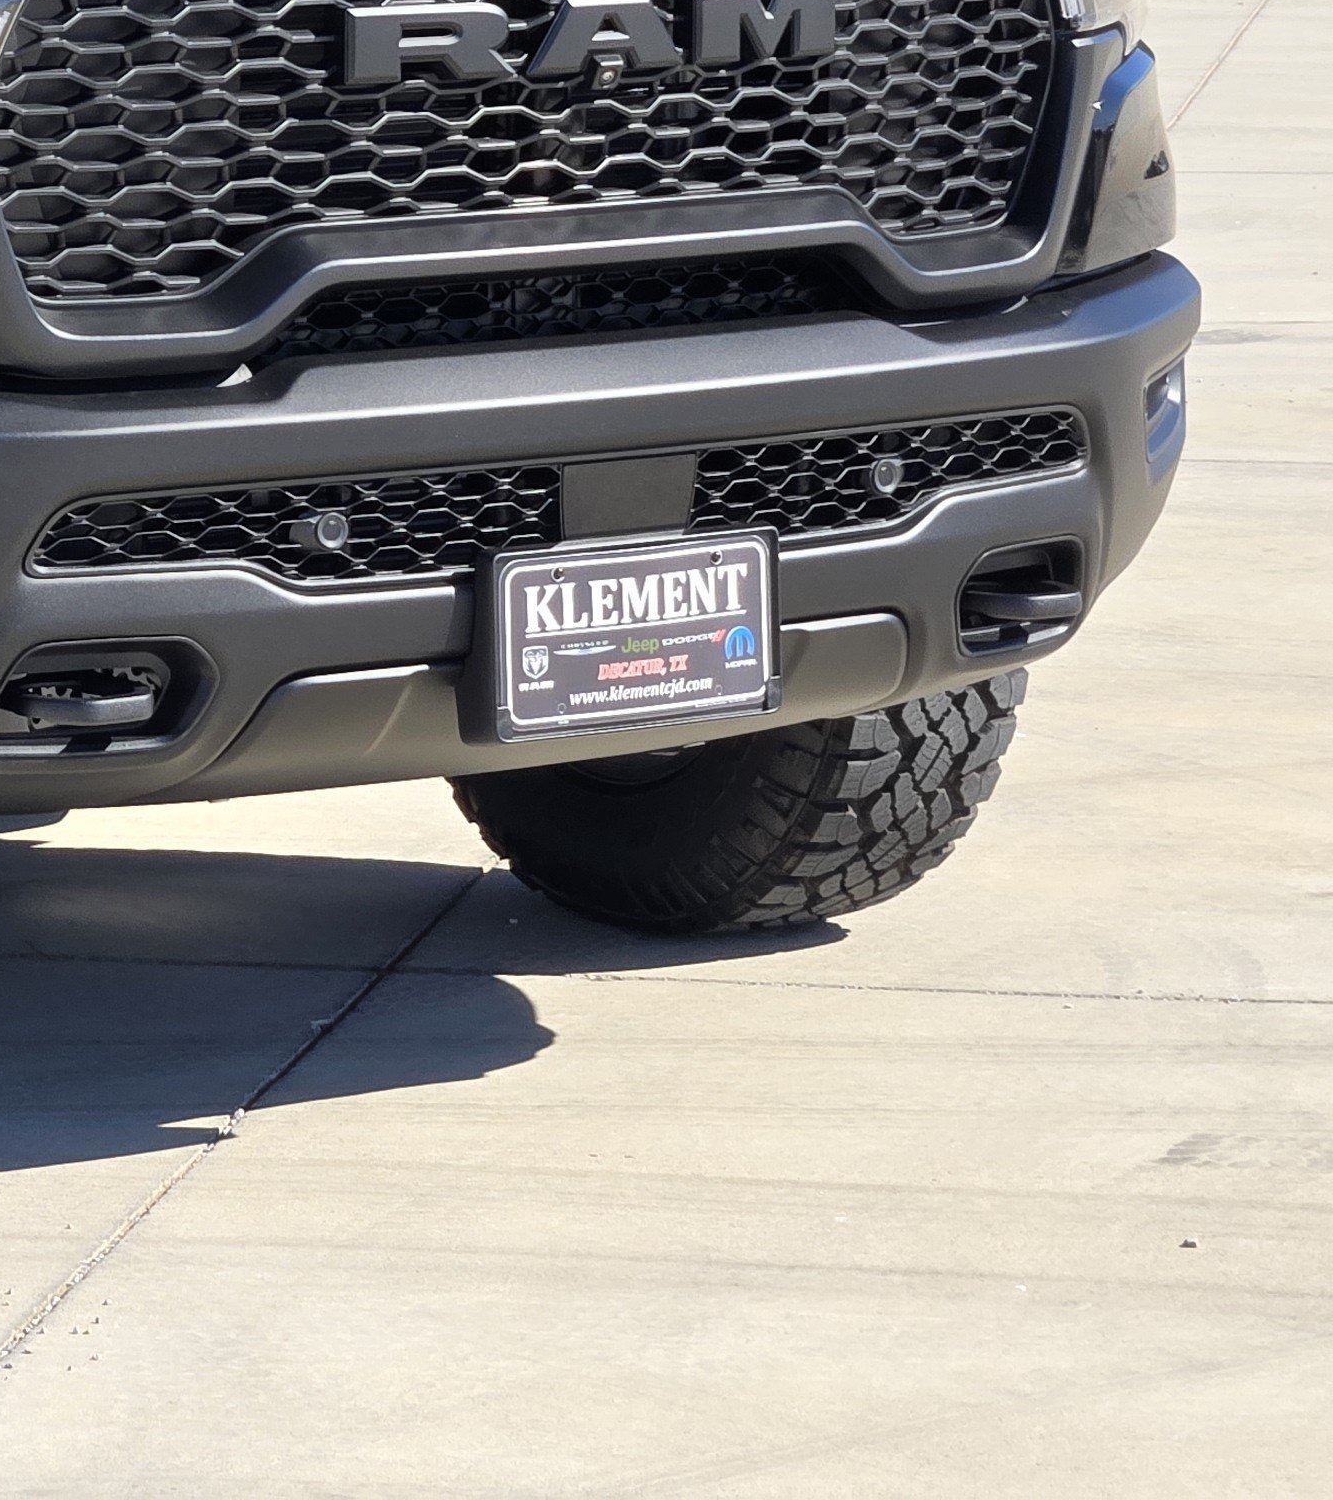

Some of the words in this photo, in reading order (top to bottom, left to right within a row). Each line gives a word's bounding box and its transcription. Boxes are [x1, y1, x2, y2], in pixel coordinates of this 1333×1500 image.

[523, 563, 748, 633] KLEMENT
[621, 636, 659, 655] Jeep
[669, 654, 689, 672] TX
[569, 676, 712, 706] www.klementcjd.com
